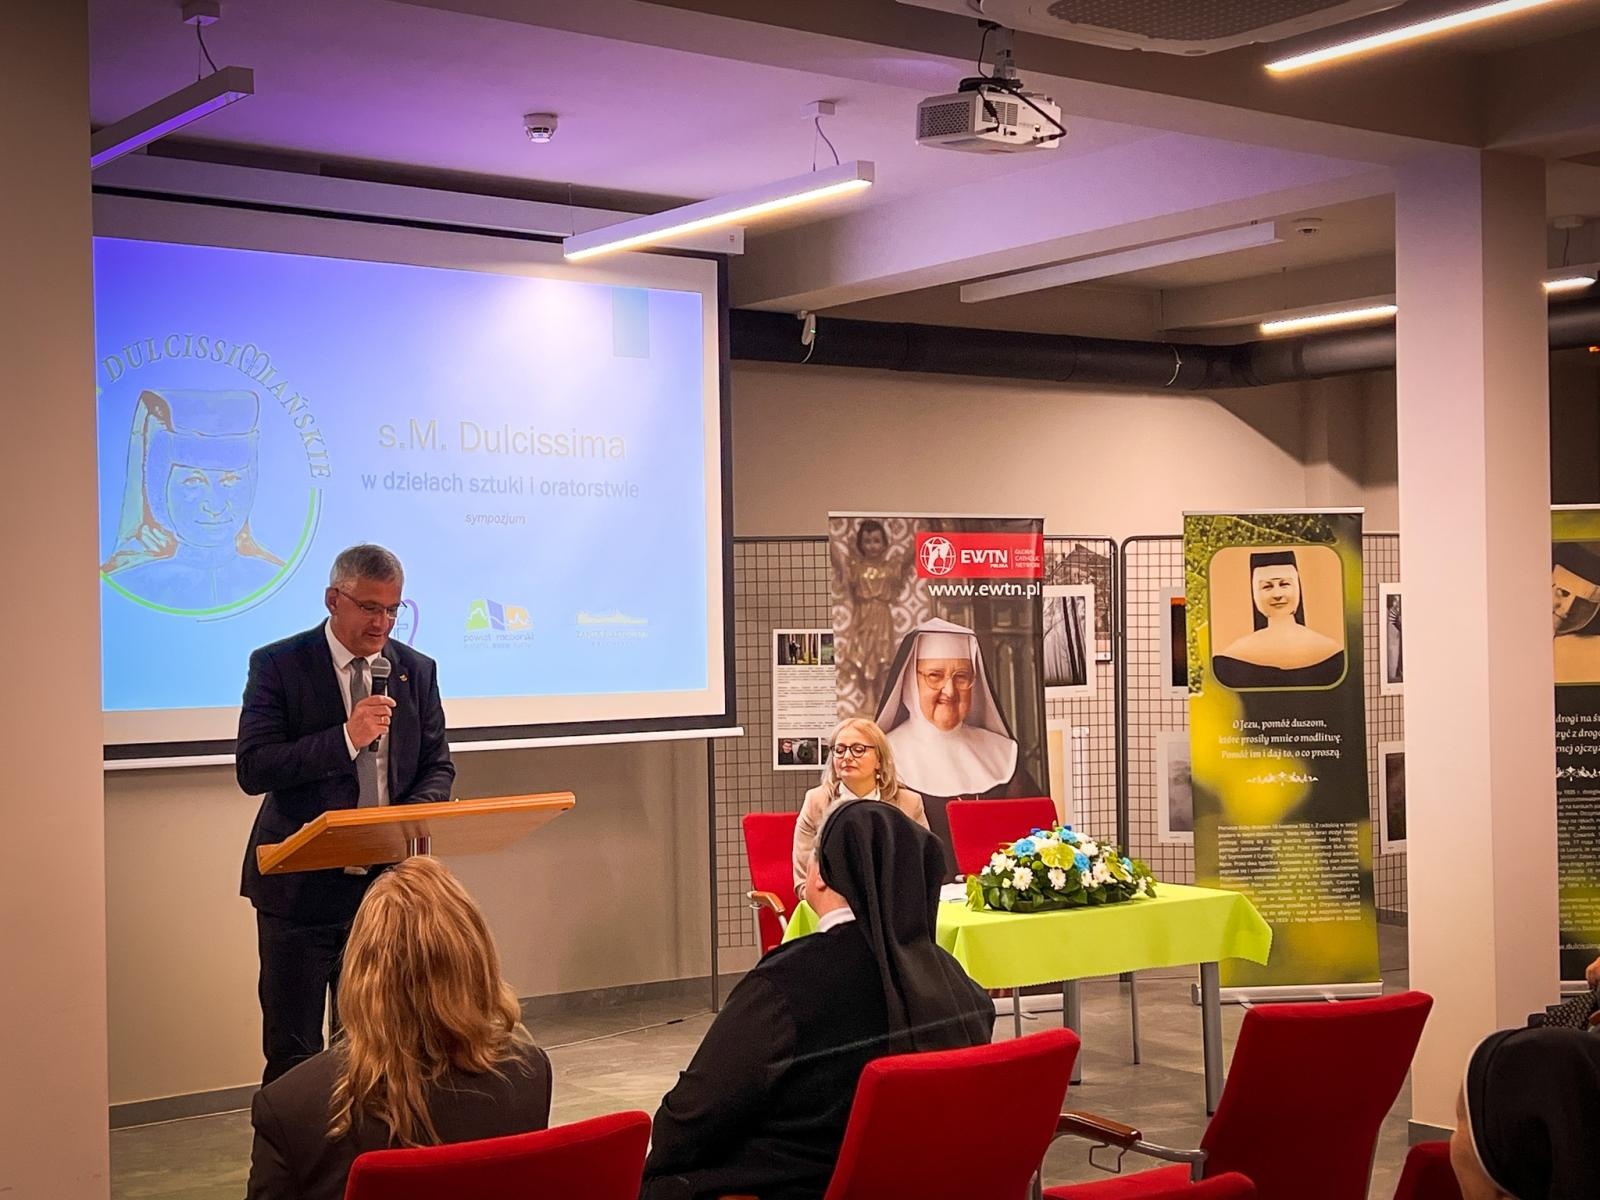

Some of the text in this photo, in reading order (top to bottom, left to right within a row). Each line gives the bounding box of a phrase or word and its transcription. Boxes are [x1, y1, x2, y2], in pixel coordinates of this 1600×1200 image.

[378, 417, 626, 460] s.M. Dulcissima
[361, 470, 640, 499] w dziełach sztuki i oratorstwie
[465, 512, 526, 525] sympozjum
[960, 549, 1008, 564] EWTN
[928, 582, 1040, 600] www.ewtn.pl
[1261, 718, 1290, 731] pomóż
[1556, 713, 1579, 726] drogi
[1240, 733, 1270, 746] prosiły
[1293, 735, 1300, 743] o
[1571, 730, 1577, 738] z
[1221, 749, 1249, 759] Pomóż
[1249, 749, 1261, 758] im
[1266, 748, 1282, 760] daj
[1282, 749, 1294, 758] to,
